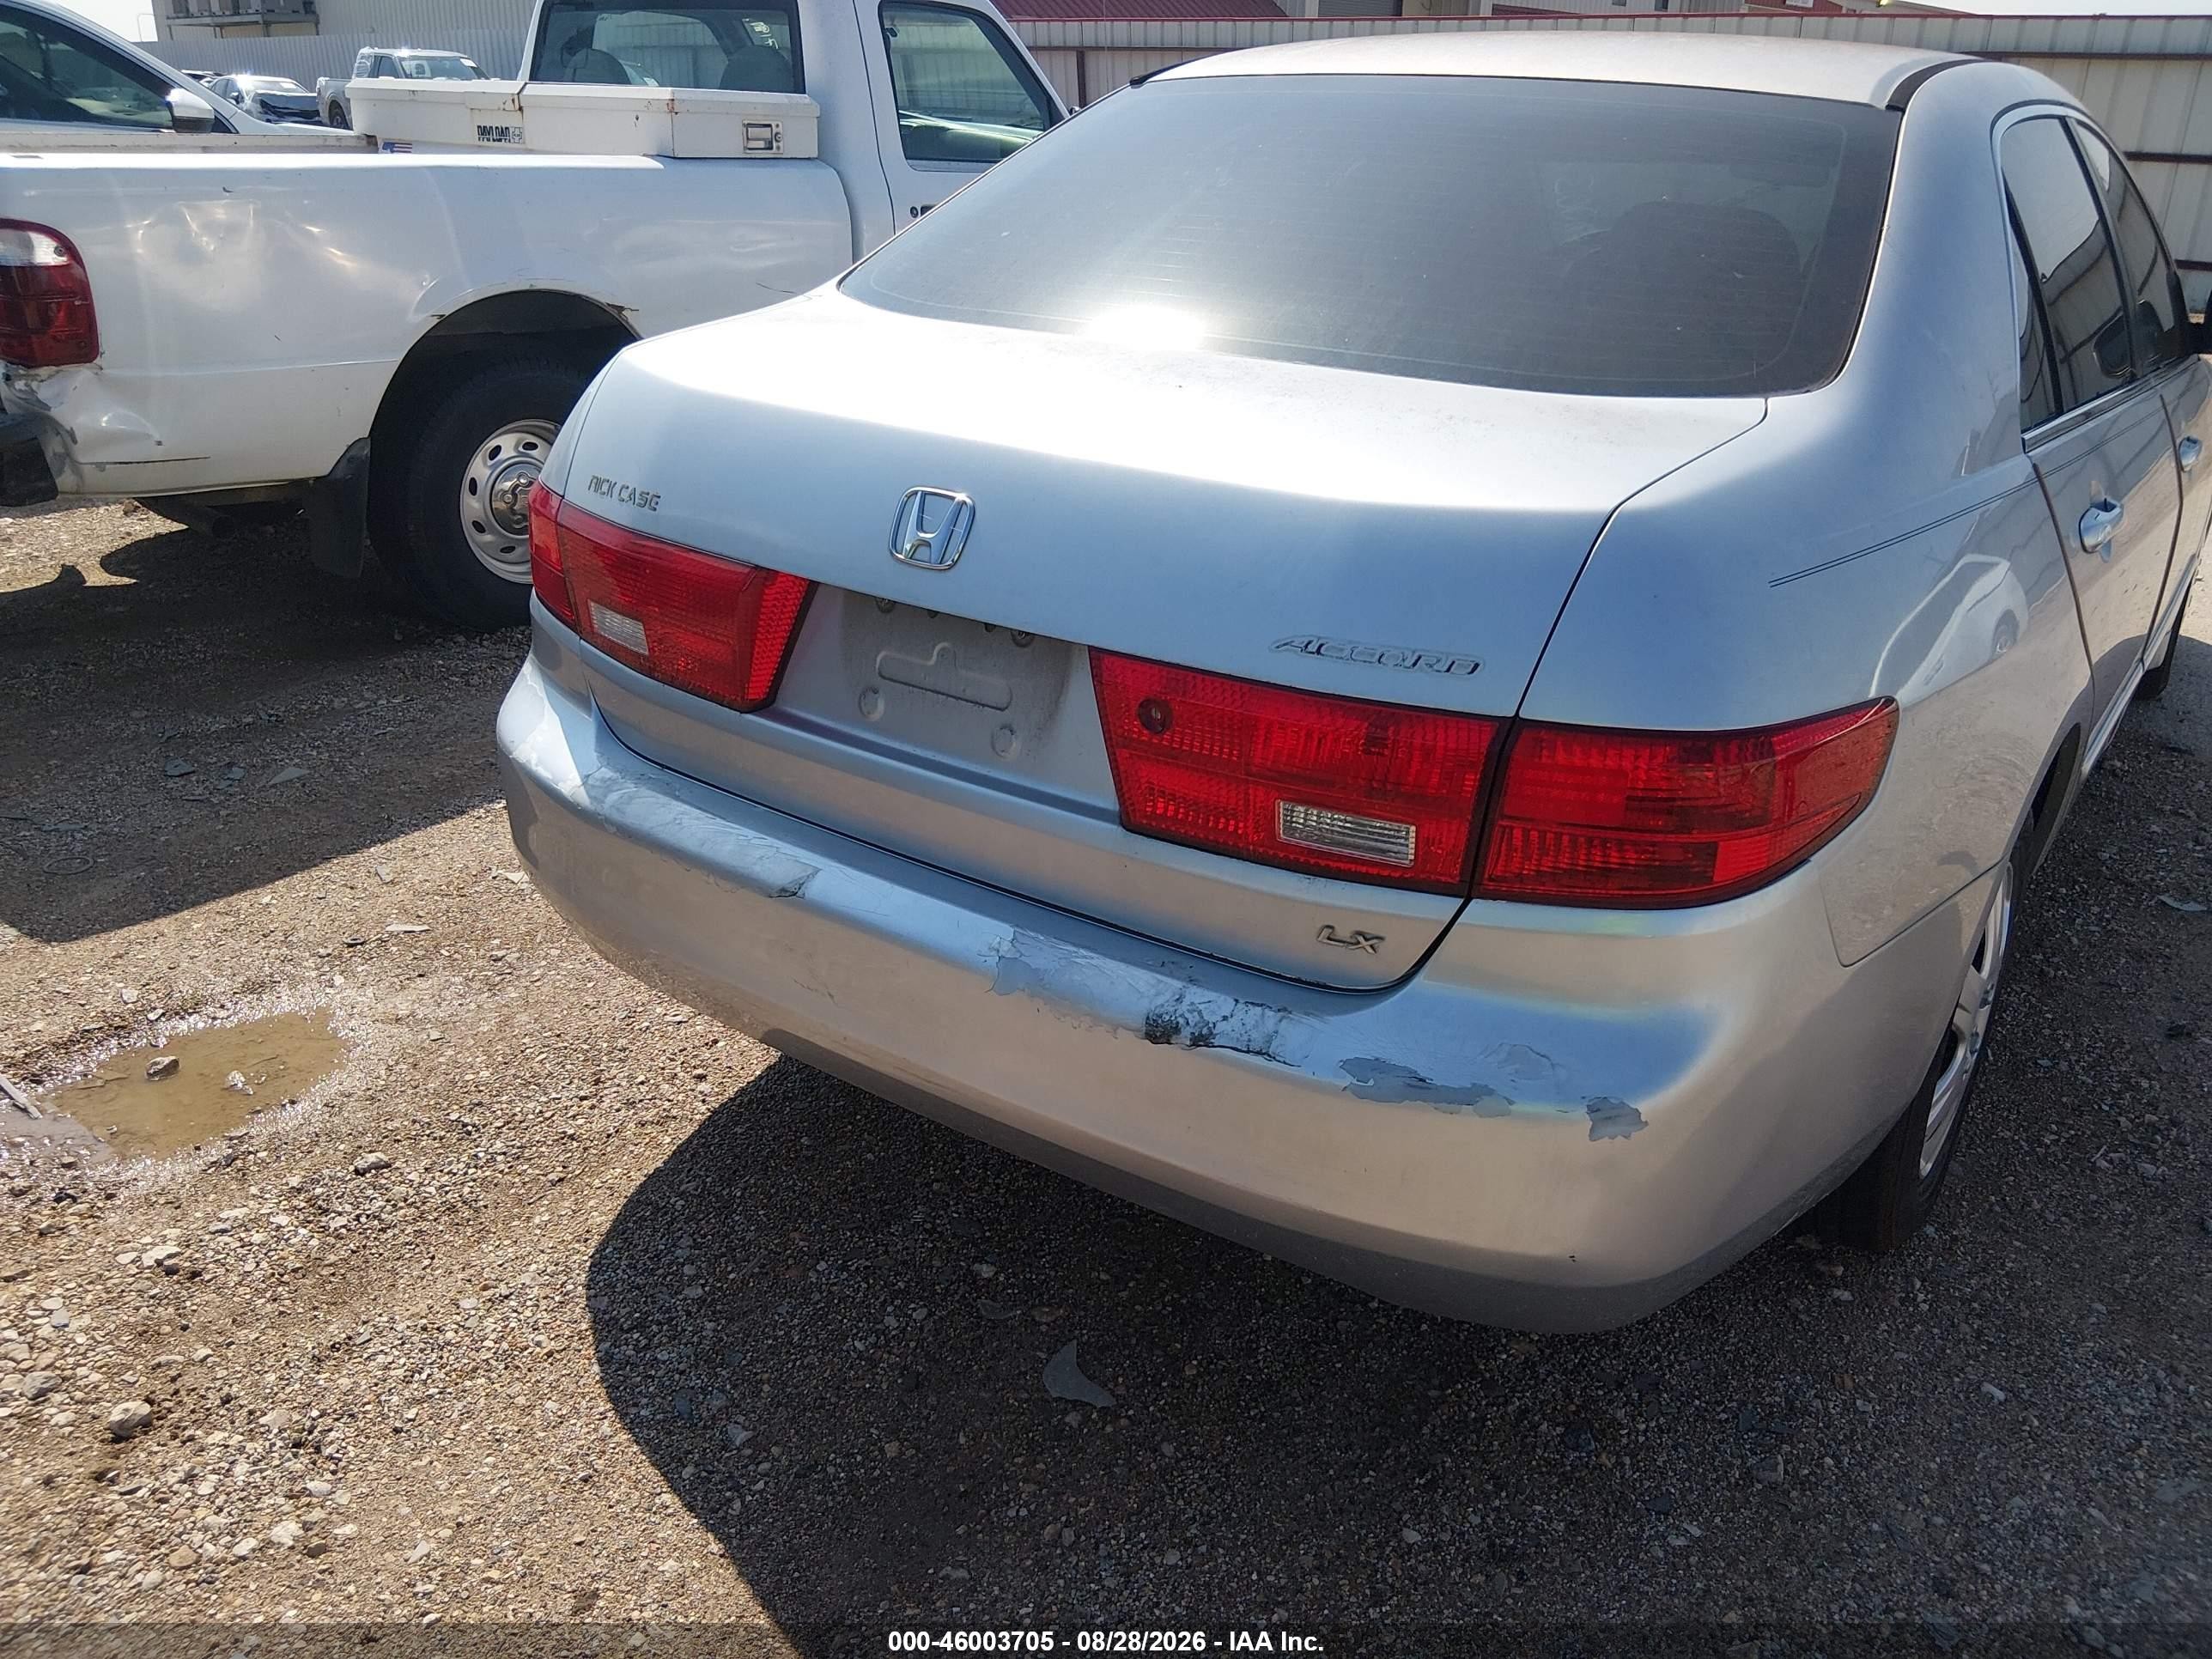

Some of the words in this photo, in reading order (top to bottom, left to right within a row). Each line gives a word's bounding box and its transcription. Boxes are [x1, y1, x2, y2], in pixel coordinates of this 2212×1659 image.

[617, 483, 661, 512] CASE
[1273, 636, 1482, 677] ACCORD
[1316, 925, 1386, 955] LX
